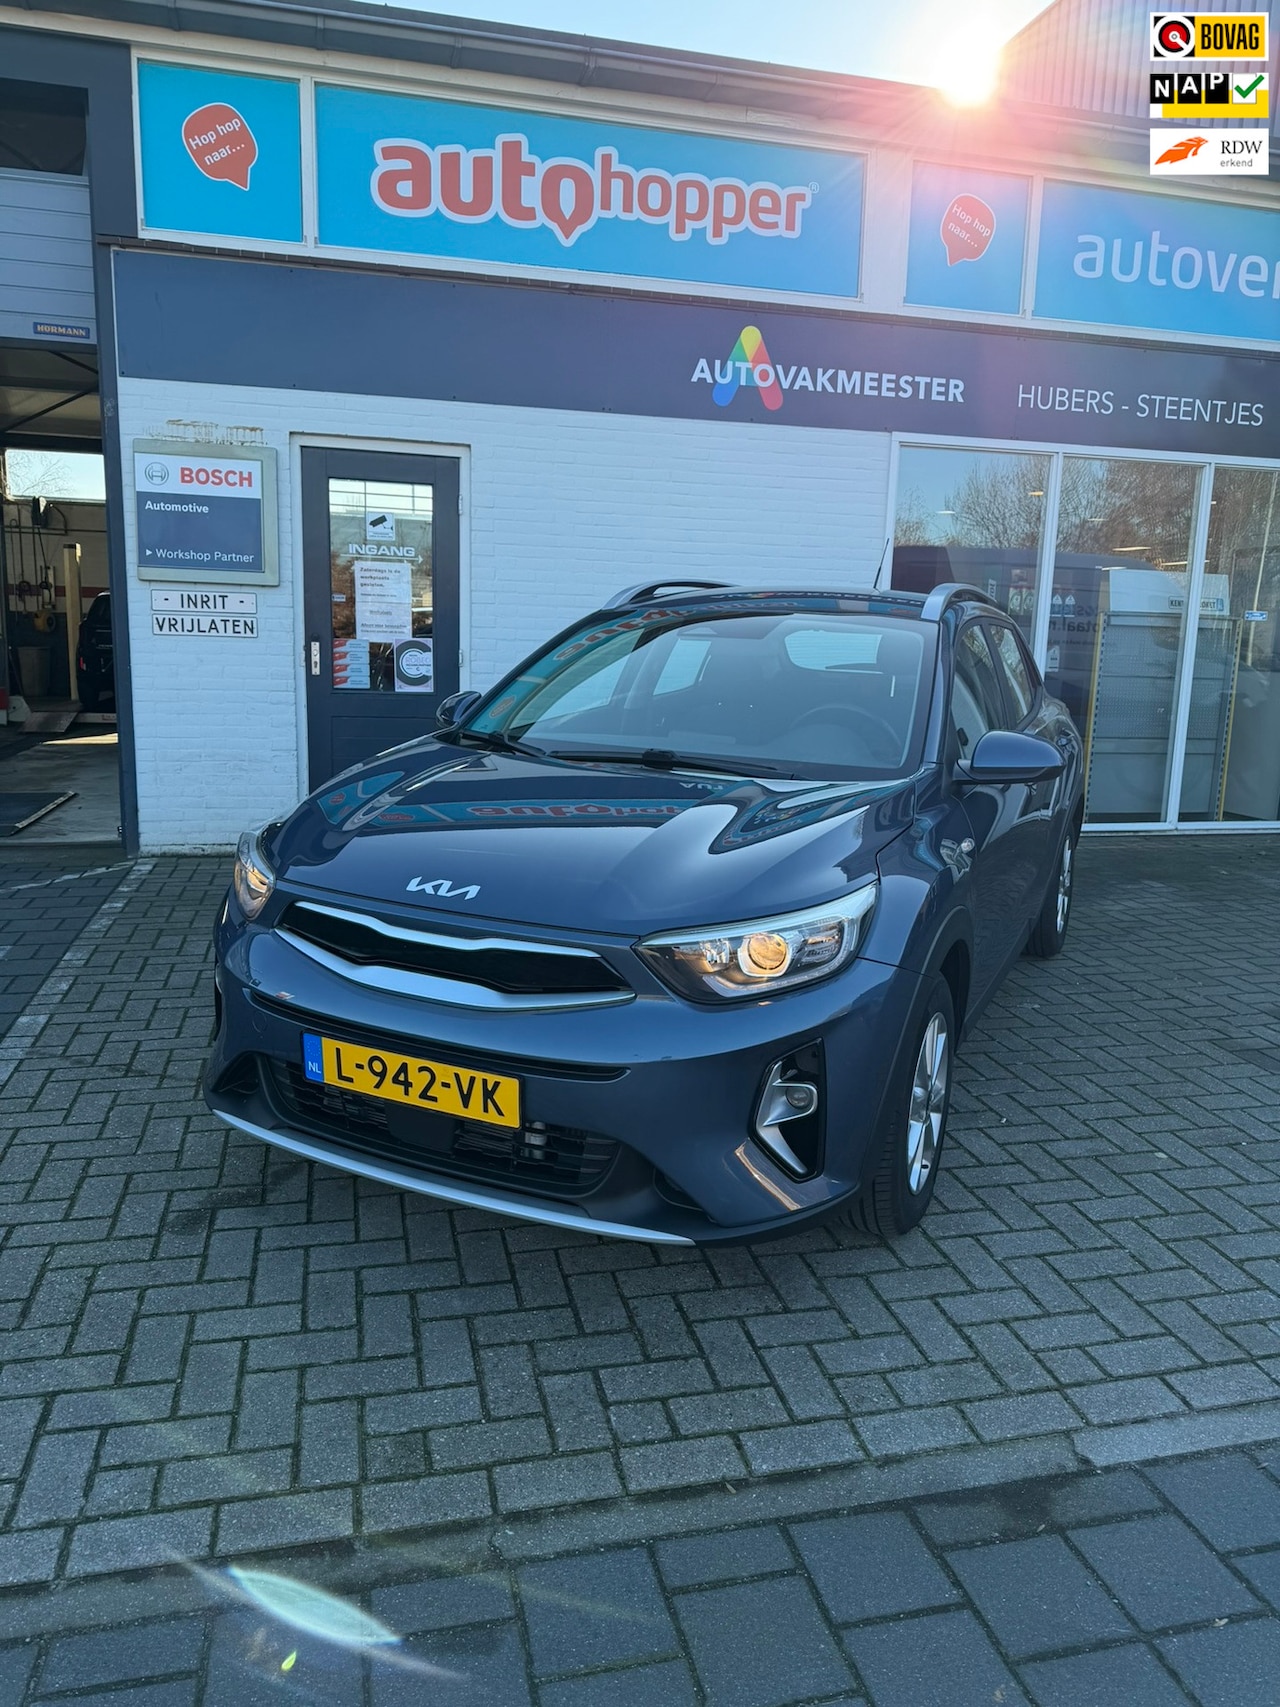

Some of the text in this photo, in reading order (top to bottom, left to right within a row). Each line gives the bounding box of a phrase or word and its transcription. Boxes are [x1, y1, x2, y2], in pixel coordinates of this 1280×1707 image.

[188, 118, 241, 150] Hop hop
[204, 144, 245, 166] naar...
[952, 203, 991, 237] Hop hop
[691, 358, 965, 403] AUTOVAKMEESTER
[1017, 383, 1115, 415] HUBERS
[1136, 394, 1265, 427] STEENTJES
[180, 466, 253, 488] BOSCH
[144, 500, 209, 514] Automotive
[155, 548, 255, 563] Workshop Partner
[348, 543, 416, 557] INGANG
[180, 593, 229, 610] INRIT
[155, 616, 255, 635] VRIJLATEN
[406, 876, 481, 900] KIA
[308, 1047, 505, 1117] NL L-942-VK
